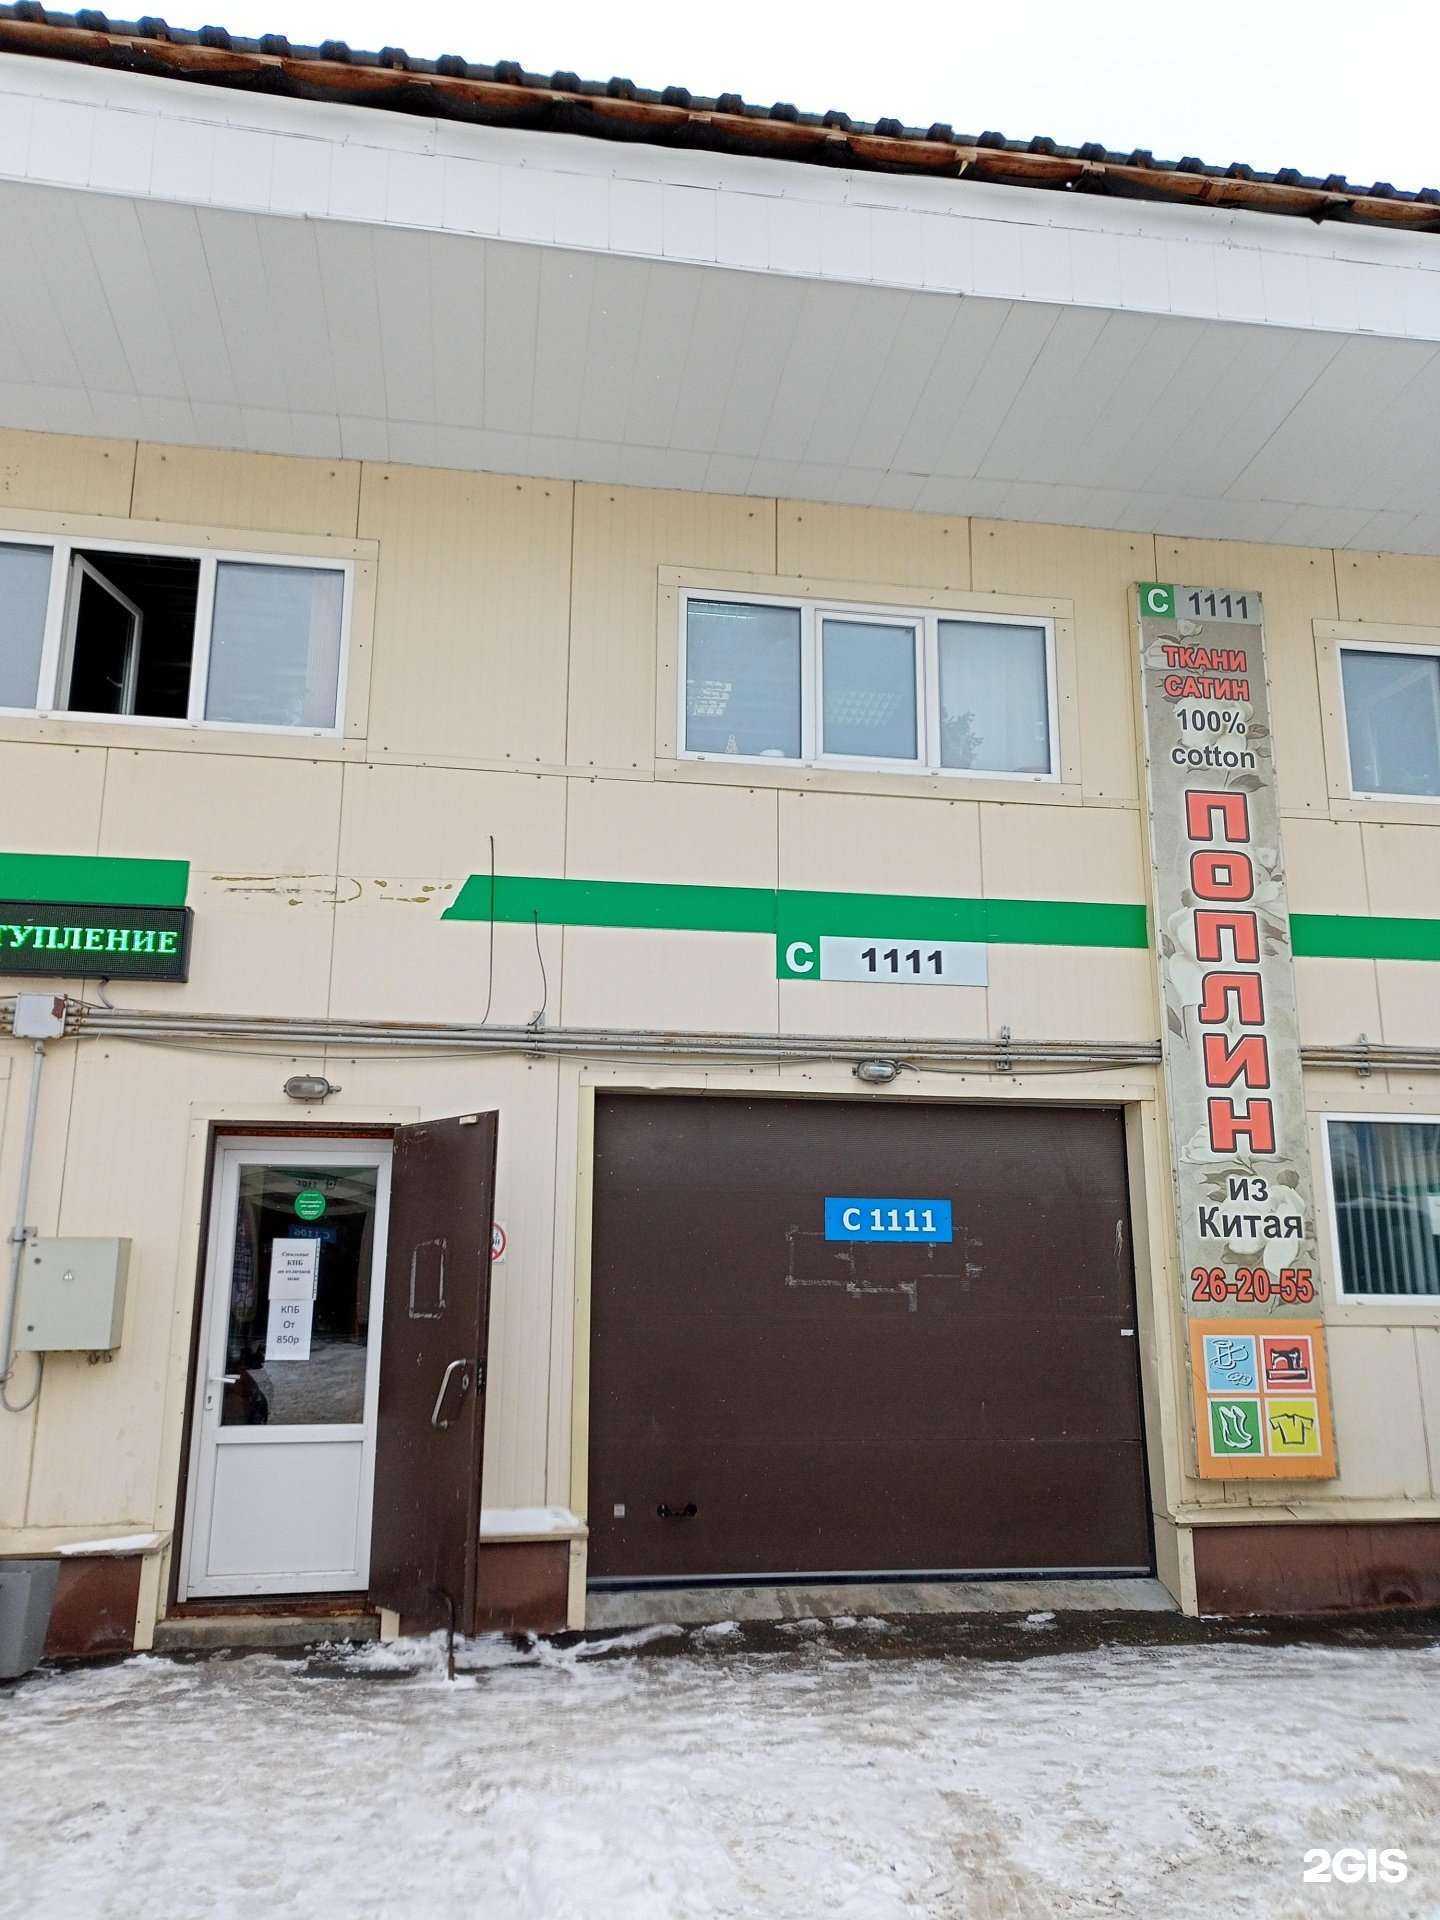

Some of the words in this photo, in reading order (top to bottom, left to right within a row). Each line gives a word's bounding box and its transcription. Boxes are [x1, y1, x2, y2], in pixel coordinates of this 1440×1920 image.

[1147, 588, 1169, 613] С
[1188, 592, 1248, 619] 1111
[1161, 645, 1248, 673] ТКАНИ
[1164, 674, 1250, 702] САТИН
[1176, 708, 1246, 735] 100%
[1171, 744, 1255, 769] cotton
[785, 941, 815, 974] С
[861, 947, 944, 975] 1111
[1184, 788, 1276, 1154] ПОПЛИН
[1229, 1178, 1269, 1202] из
[842, 1207, 861, 1231] С
[870, 1208, 937, 1232] 1111
[1198, 1206, 1304, 1239] Китая
[1190, 1266, 1314, 1303] 26-20-55
[281, 1305, 300, 1315] КПБ
[283, 1320, 296, 1329] От
[276, 1335, 300, 1346] 850р
